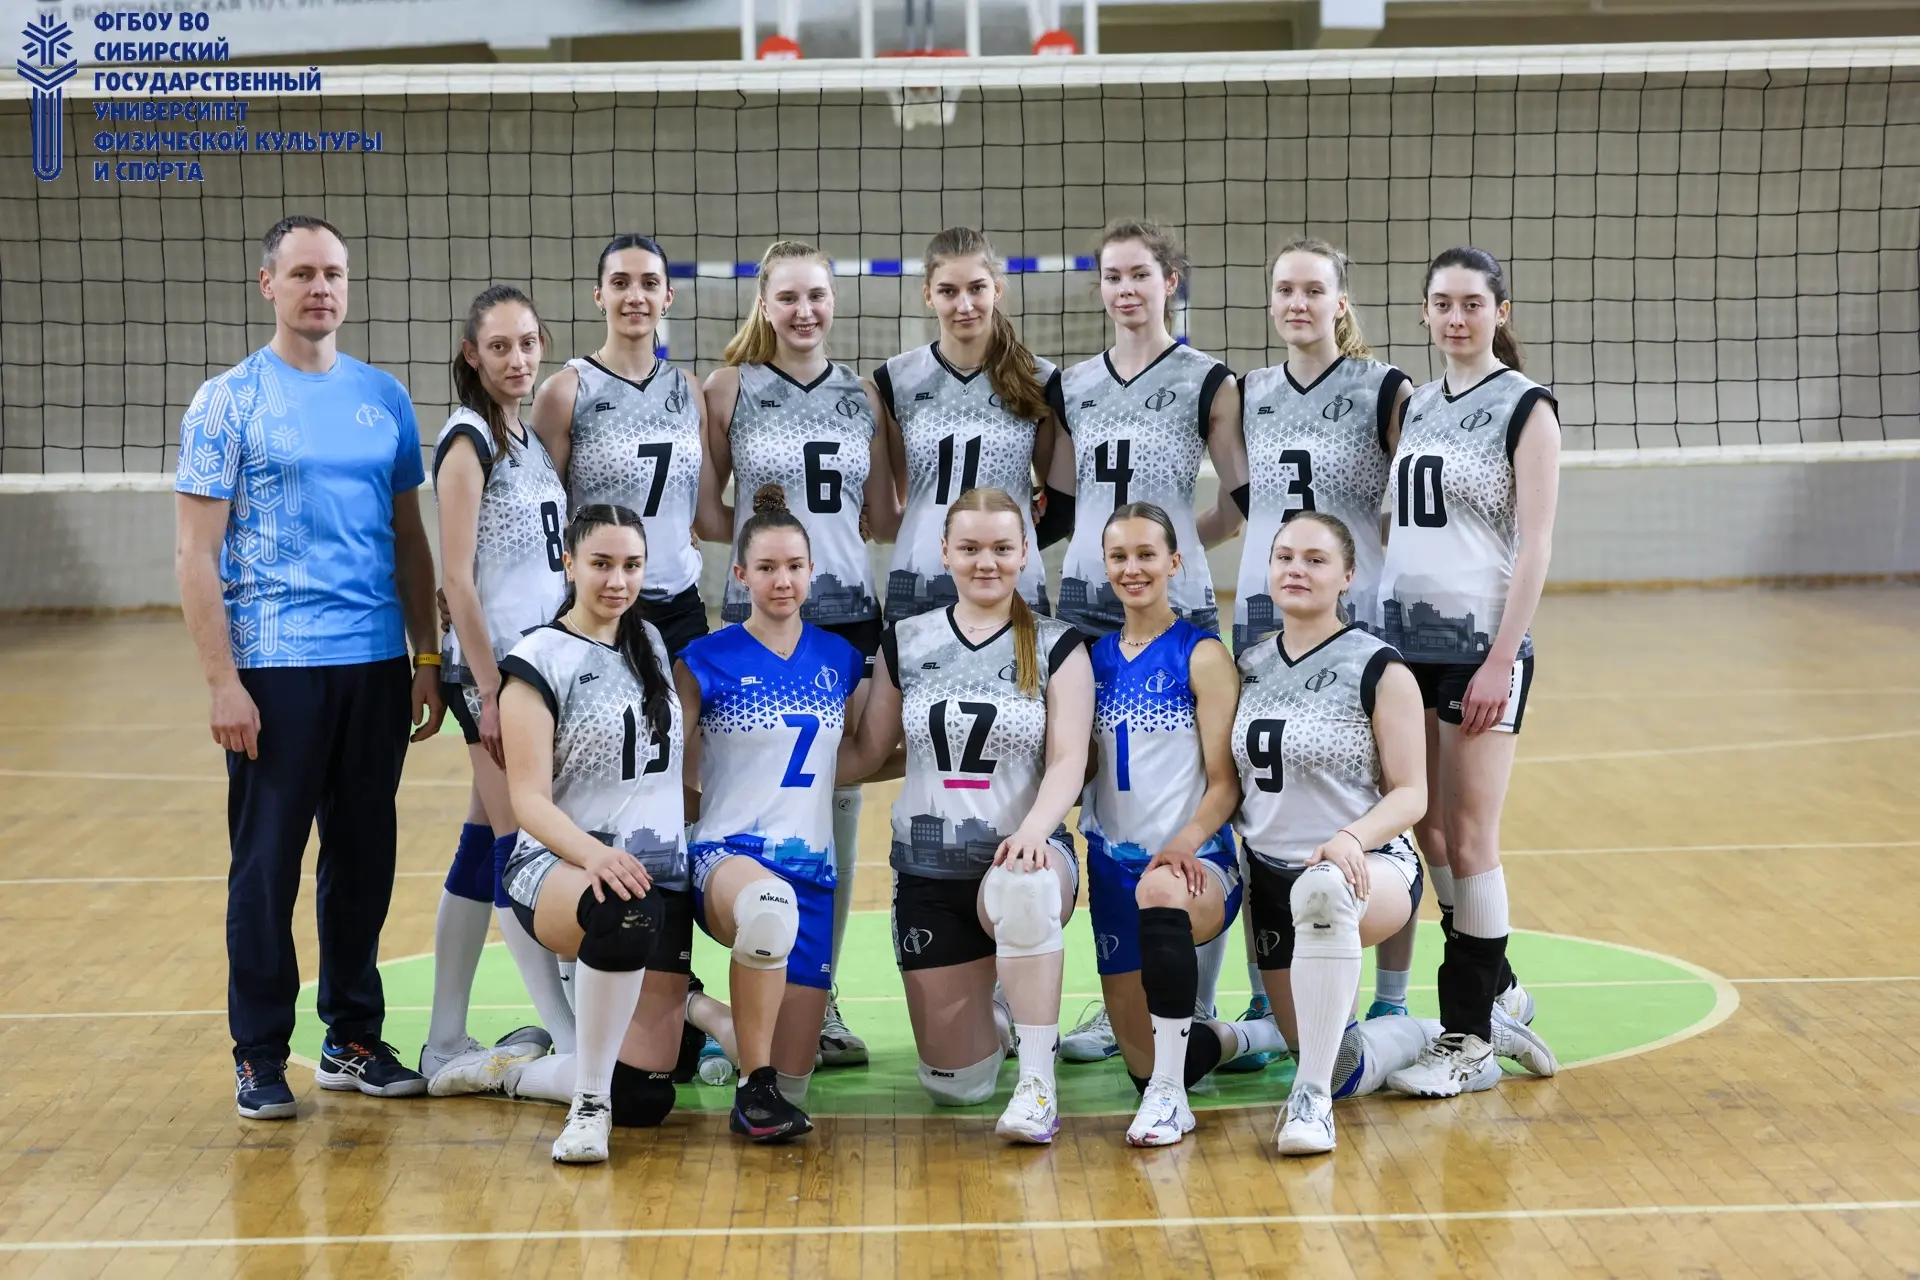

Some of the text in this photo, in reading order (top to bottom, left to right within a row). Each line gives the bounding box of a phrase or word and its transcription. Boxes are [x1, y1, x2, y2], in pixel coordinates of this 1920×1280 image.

[595, 402, 616, 412] SL
[761, 400, 780, 408] SL
[914, 392, 934, 401] SL
[1081, 400, 1097, 409] SL
[1258, 406, 1275, 415] SL
[637, 442, 673, 517] 7
[803, 441, 842, 513] 6
[935, 433, 981, 505] 11
[1095, 439, 1134, 512] 4
[1278, 449, 1316, 523] 3
[1398, 453, 1448, 527] 10
[541, 501, 565, 572] 8
[579, 673, 599, 685] SL
[741, 676, 762, 686] SL
[921, 662, 940, 670] SL
[622, 700, 672, 780] 13
[780, 714, 820, 787] 2
[929, 699, 998, 774] 12
[1115, 718, 1130, 791] 1
[1246, 719, 1287, 793] 9
